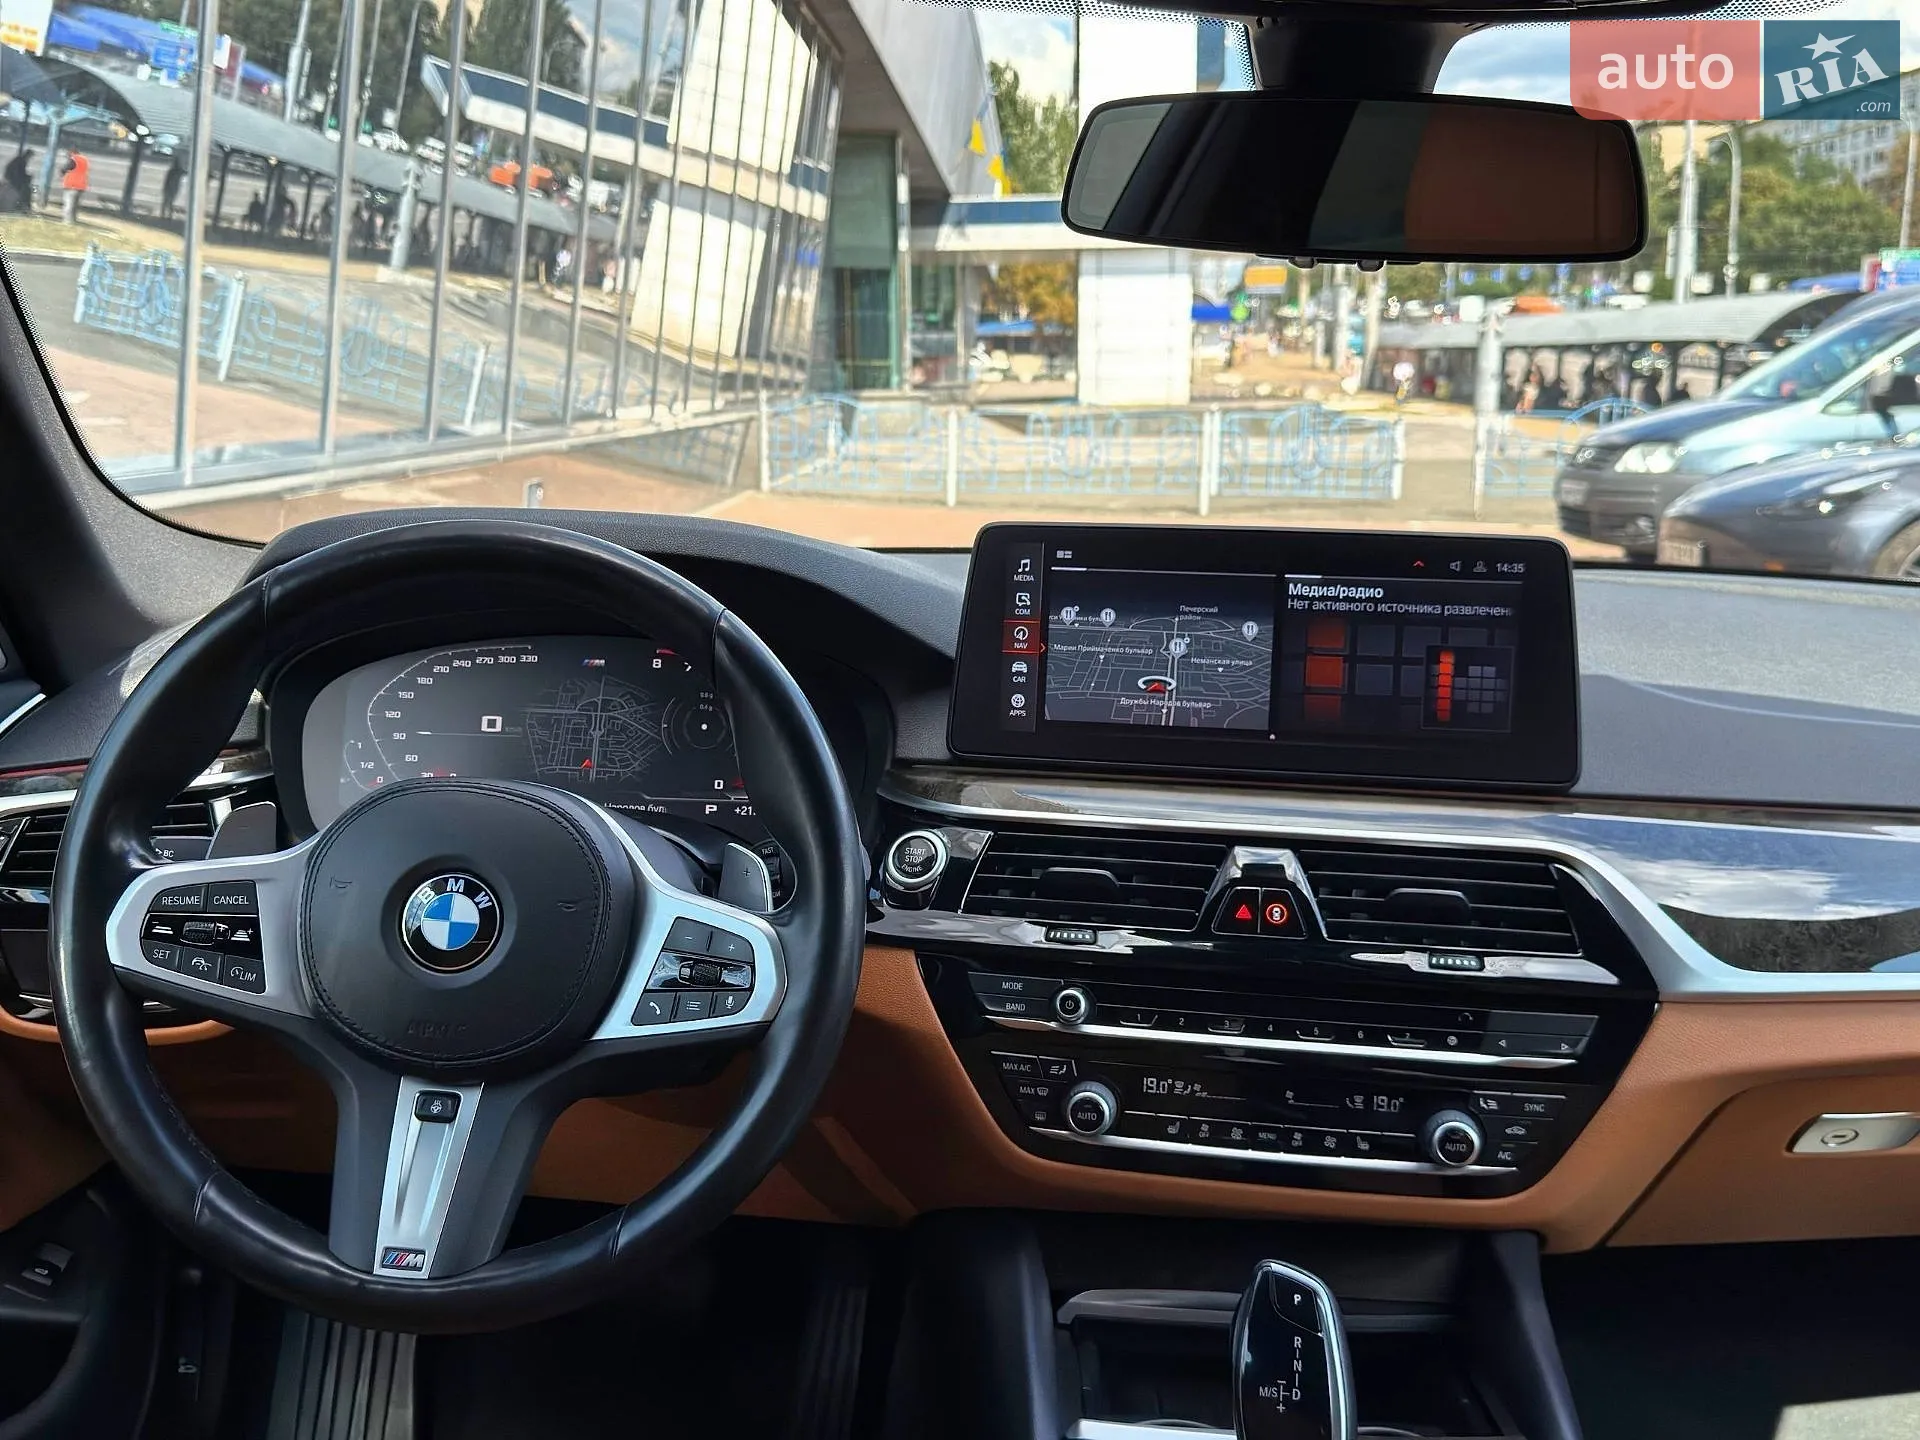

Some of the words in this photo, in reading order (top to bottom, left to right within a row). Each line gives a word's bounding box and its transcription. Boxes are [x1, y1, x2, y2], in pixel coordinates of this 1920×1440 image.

[1496, 563, 1525, 573] 14:35
[1013, 574, 1035, 582] MEDIA
[1288, 583, 1384, 599] Медиа/радио
[1179, 605, 1218, 614] Печерский
[1287, 599, 1311, 610] Нет
[1312, 602, 1375, 612] активного
[1377, 603, 1441, 614] источника
[1179, 614, 1202, 622] район
[1053, 643, 1077, 651] Марии
[1077, 644, 1124, 654] Приймаченко
[1125, 647, 1153, 656] бульвар
[452, 659, 472, 668] 240
[475, 656, 494, 665] 270
[497, 655, 517, 664] 300
[519, 654, 538, 663] 330
[1191, 657, 1230, 665] Неманская
[652, 659, 662, 669] 8
[433, 665, 450, 674] 210
[416, 676, 433, 686] 180
[398, 691, 414, 700] 150
[1120, 697, 1149, 705] Дружбы
[1150, 698, 1181, 707] Народов
[1182, 700, 1212, 709] бульвар
[385, 710, 401, 719] 120
[1009, 709, 1027, 717] APPS
[481, 715, 503, 732] 0
[392, 732, 406, 741] 90
[405, 754, 418, 763] 60
[360, 761, 375, 770] 1/2
[376, 775, 384, 784] 0
[714, 779, 724, 790] 0
[705, 804, 718, 814] P
[904, 847, 926, 855] START
[904, 855, 923, 863] STOP
[417, 877, 493, 910] BMW
[162, 896, 200, 905] RESUME
[213, 895, 249, 905] CANCEL
[152, 949, 171, 960] SET
[239, 971, 257, 983] LIM
[1001, 981, 1024, 991] MODE
[1005, 1002, 1026, 1012] BAND
[1178, 1017, 1185, 1026] 2
[1223, 1020, 1230, 1028] 3
[1267, 1024, 1274, 1032] 4
[1313, 1026, 1319, 1035] 5
[1357, 1030, 1364, 1039] 6
[1003, 1062, 1018, 1071] MAX
[1019, 1063, 1032, 1072] A/C
[1019, 1085, 1036, 1095] MAX
[1523, 1102, 1545, 1112] SYNC
[1076, 1110, 1098, 1121] AUTO
[1444, 1142, 1467, 1152] AUTO
[1293, 1293, 1302, 1305] P
[1294, 1336, 1302, 1348] R
[1293, 1359, 1302, 1372] N
[1259, 1385, 1278, 1397] M/S
[1292, 1388, 1301, 1400] D
